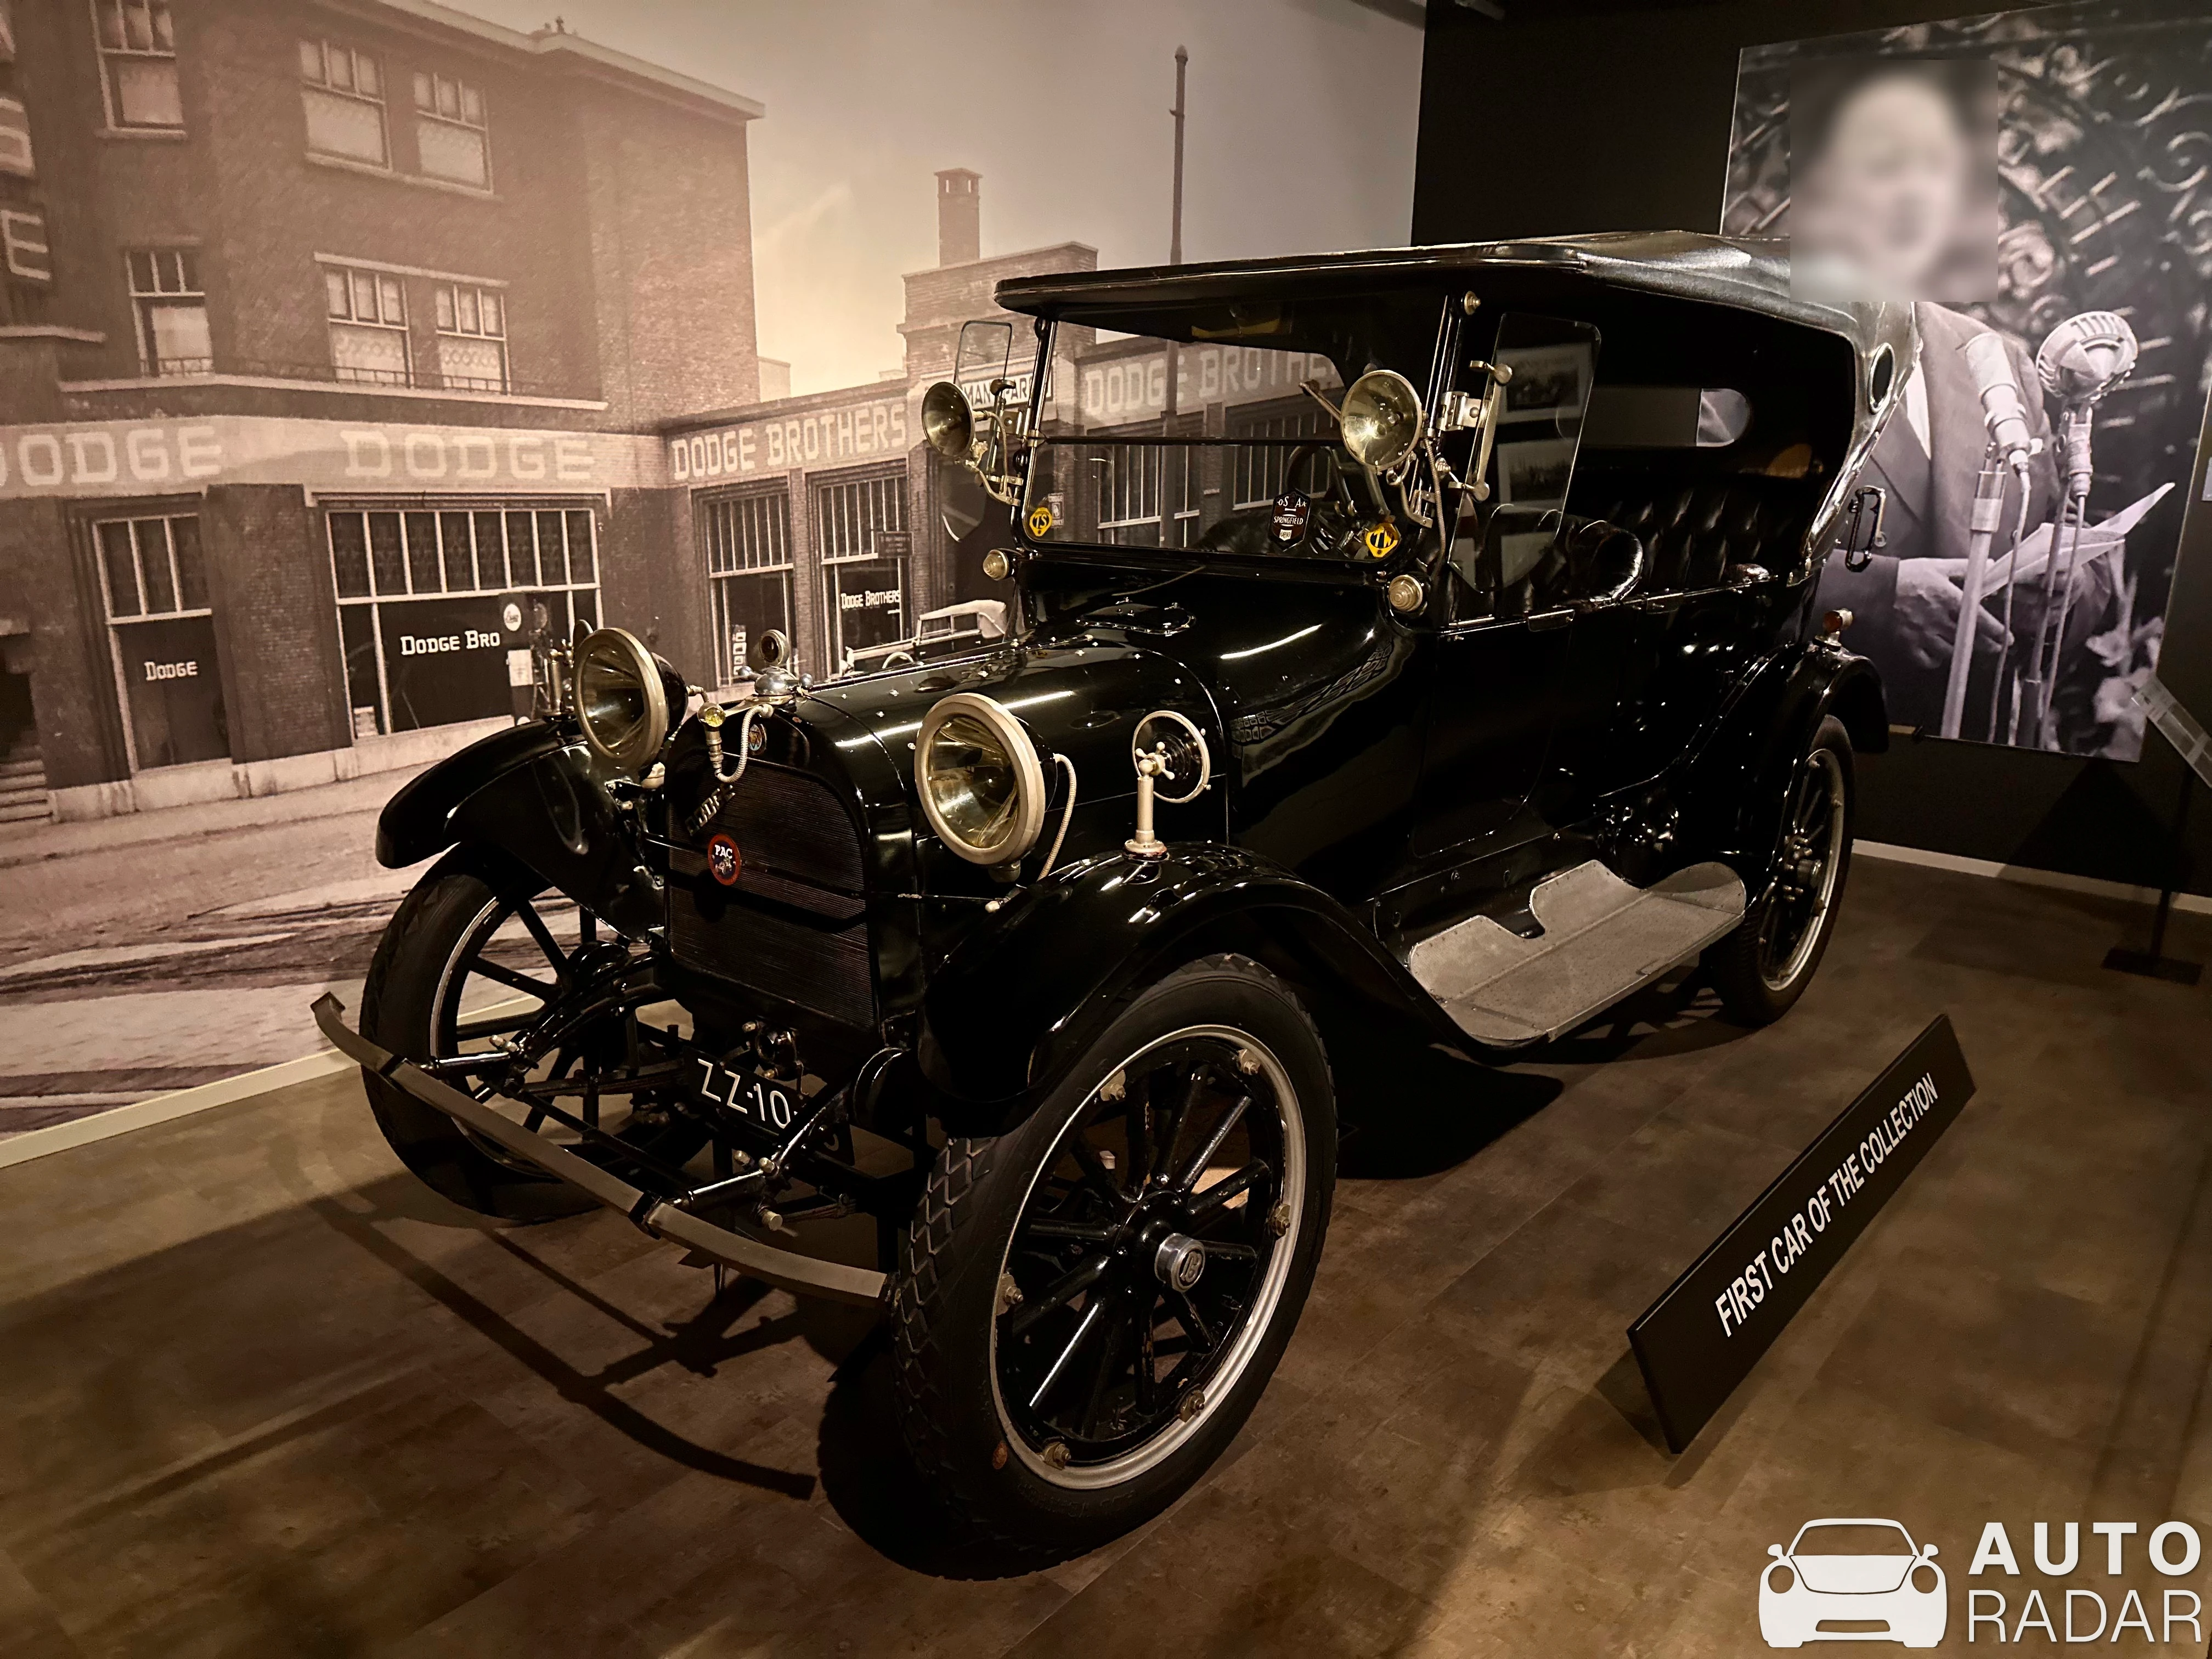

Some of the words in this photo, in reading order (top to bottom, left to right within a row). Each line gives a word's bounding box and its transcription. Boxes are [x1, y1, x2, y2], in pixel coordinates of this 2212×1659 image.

[672, 428, 757, 480] DODGE
[765, 403, 907, 466] BROTHERS
[0, 426, 222, 487] ODGE
[340, 431, 595, 479] DODGE
[1273, 516, 1304, 525] SPRINGFIELD
[840, 593, 864, 610] DODGE
[865, 590, 900, 606] BROTHERS
[400, 635, 461, 656] DODGE
[465, 630, 500, 650] BRO
[144, 661, 198, 681] DODGE
[714, 844, 733, 859] PAC
[1715, 1251, 1773, 1337] FIRST
[1771, 1213, 1813, 1273] CAR
[1808, 1185, 1831, 1232] OF
[1829, 1153, 1865, 1207] THE
[1860, 1073, 1938, 1174] COLLECTION
